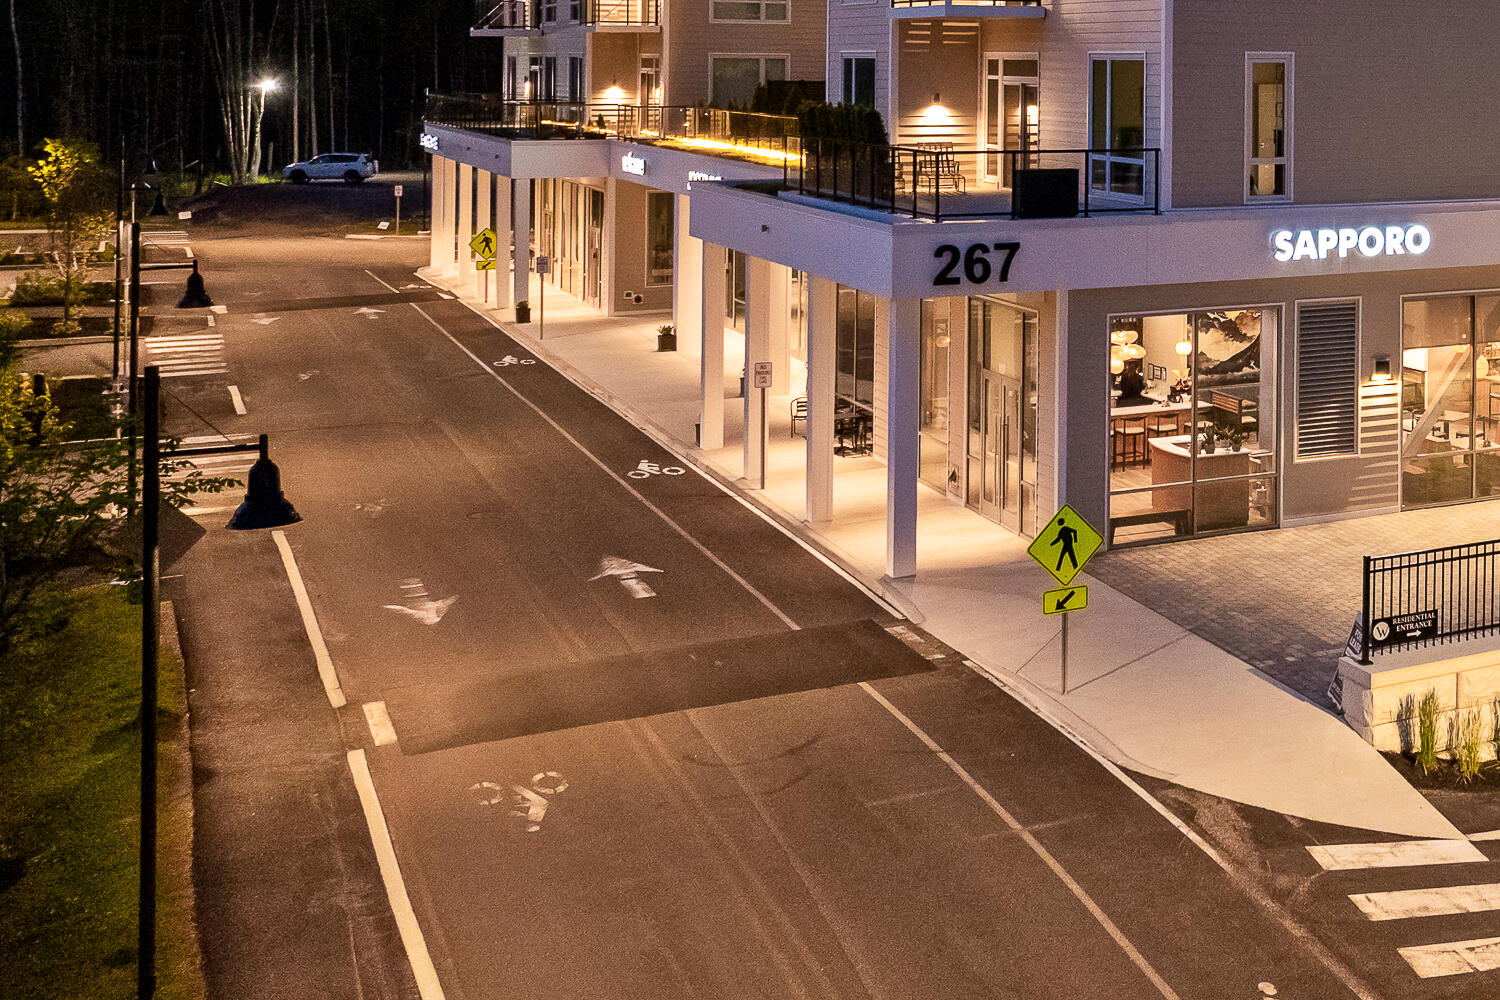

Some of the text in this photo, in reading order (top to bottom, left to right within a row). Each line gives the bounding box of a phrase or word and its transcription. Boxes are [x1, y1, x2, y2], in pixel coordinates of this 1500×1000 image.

[1273, 225, 1431, 262] SAPPORO
[933, 242, 1021, 286] 267
[1392, 612, 1436, 624] RESIDENTIAL
[1396, 620, 1433, 632] ENTRANCE
